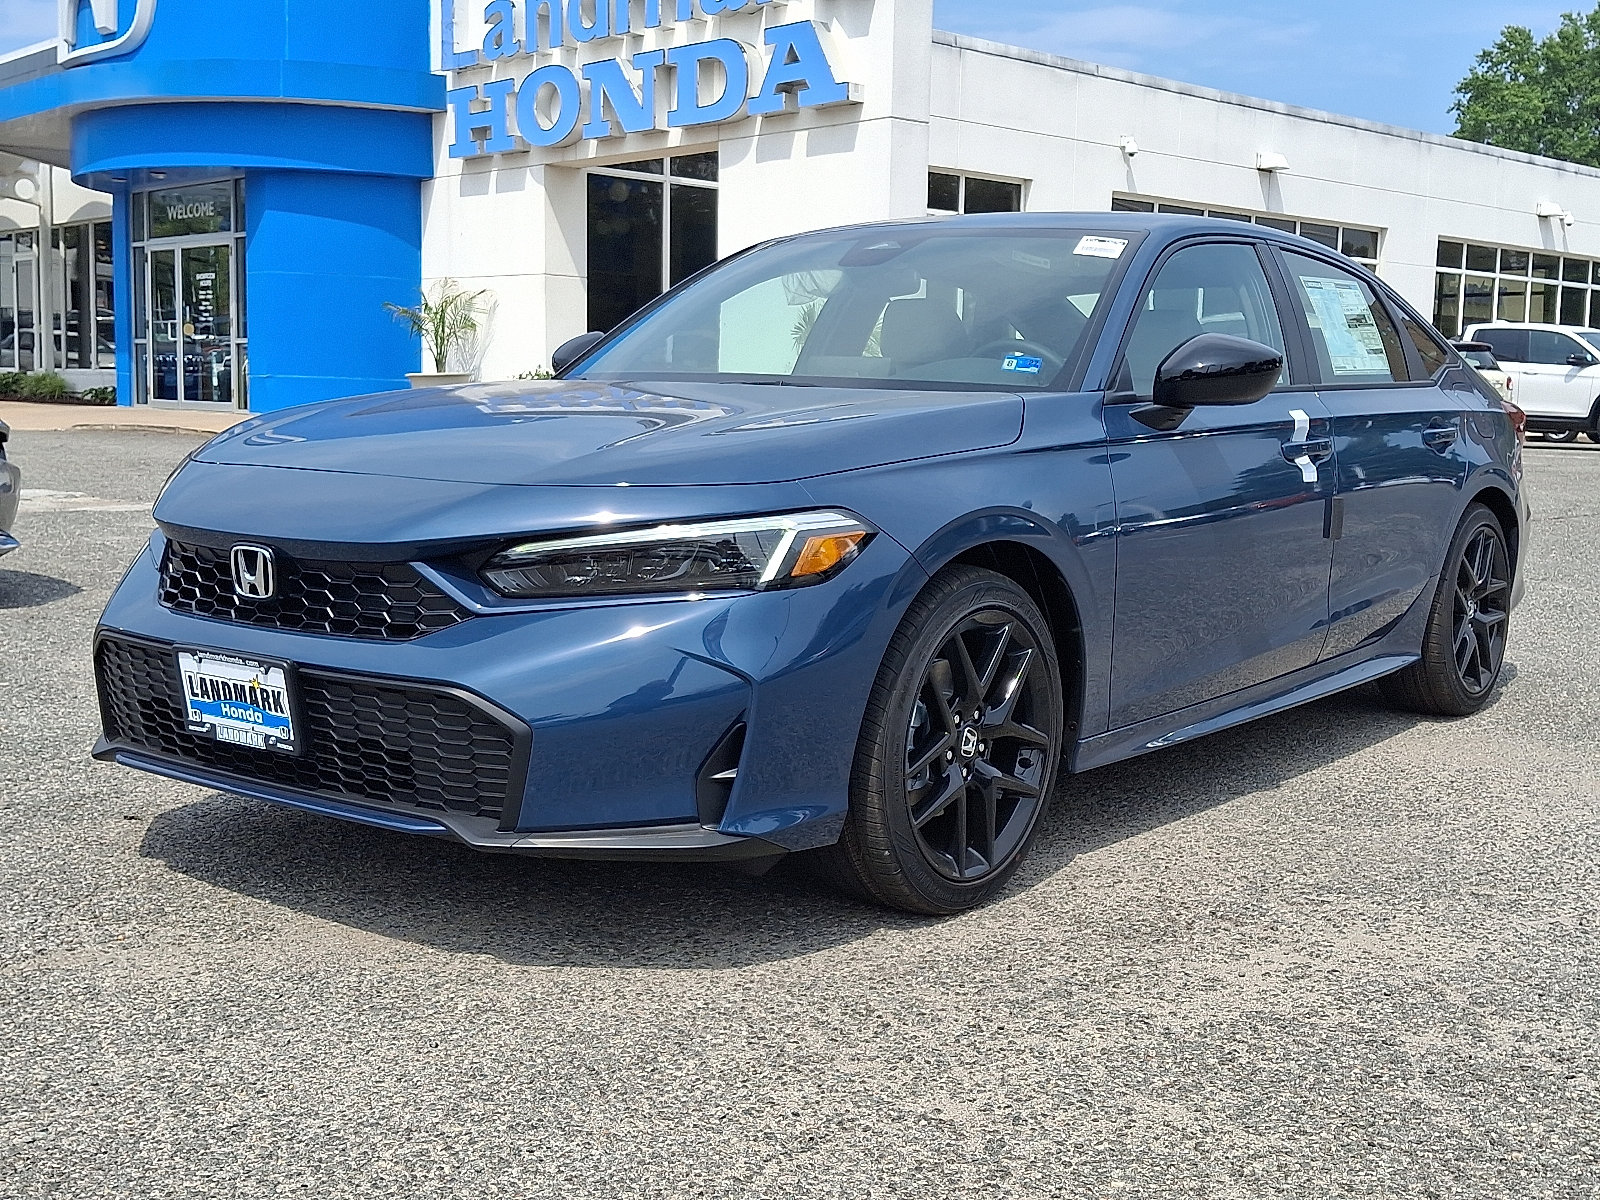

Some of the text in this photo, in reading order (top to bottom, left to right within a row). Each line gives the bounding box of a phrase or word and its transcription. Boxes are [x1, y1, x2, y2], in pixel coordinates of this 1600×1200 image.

[447, 20, 848, 158] HONDA
[167, 201, 215, 221] WELCOME
[187, 674, 285, 716] LANDMARK
[220, 703, 264, 724] Honda
[217, 725, 265, 748] LANDMARK
